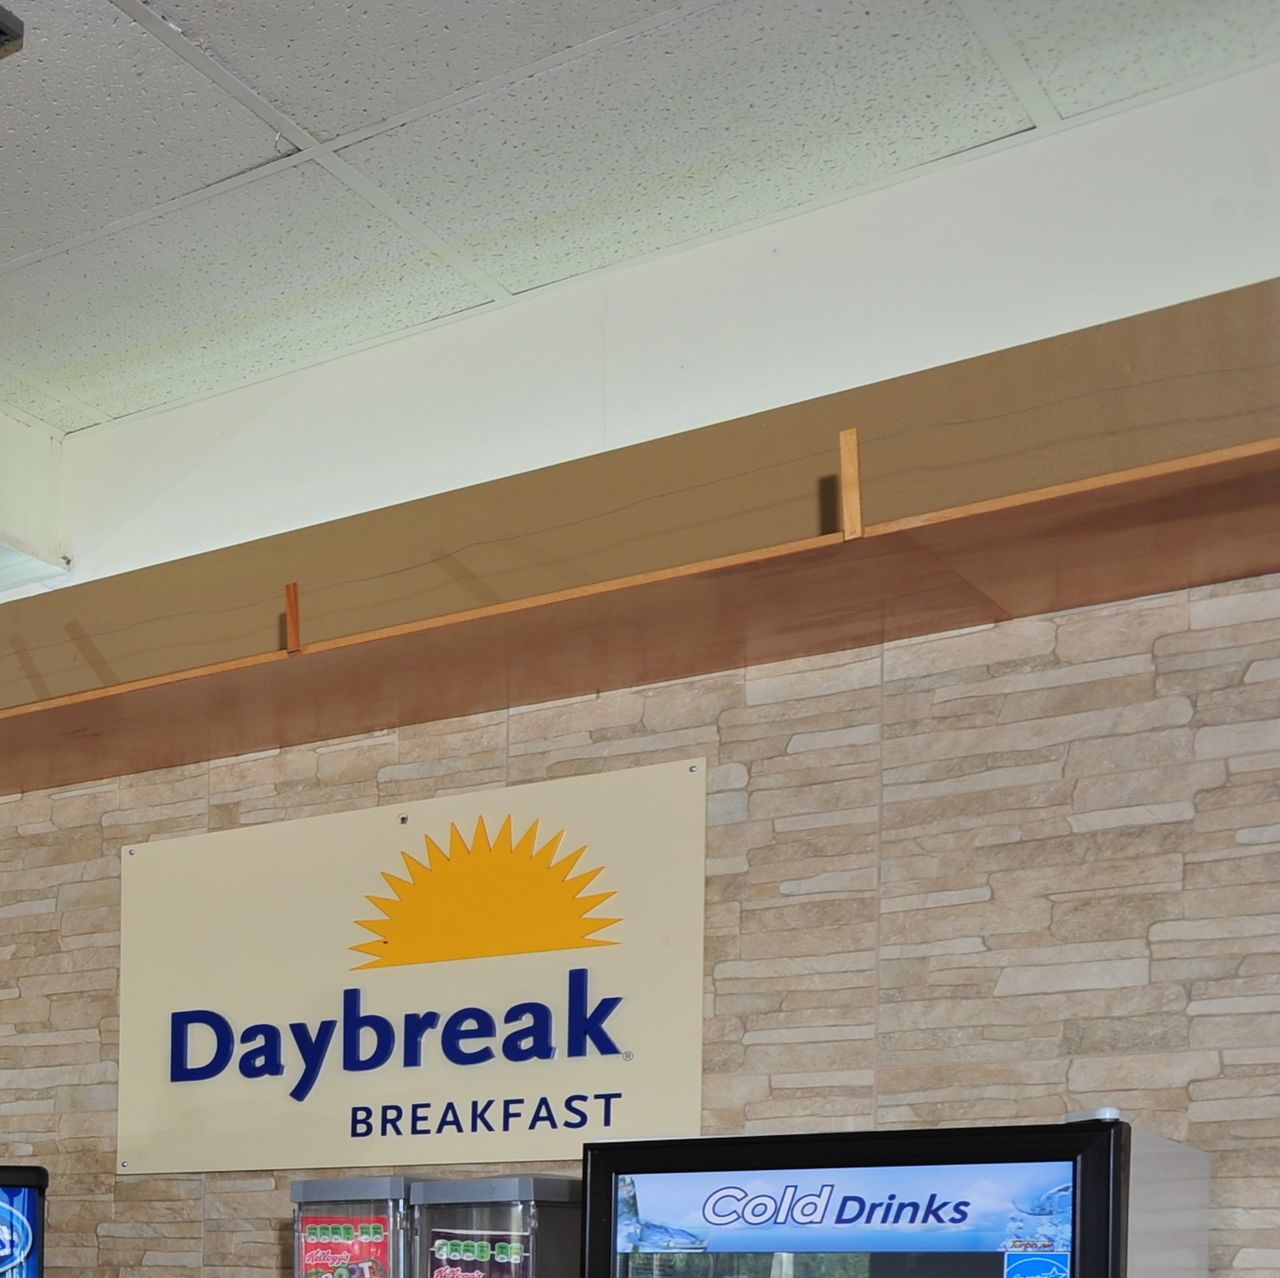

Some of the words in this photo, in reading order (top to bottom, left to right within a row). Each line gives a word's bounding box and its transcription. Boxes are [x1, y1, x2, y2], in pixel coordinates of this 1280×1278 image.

[170, 968, 624, 1102] Daybreak
[350, 1092, 623, 1138] BREAKFAST
[702, 1184, 834, 1226] Cold
[834, 1193, 971, 1226] Drinks
[305, 1250, 350, 1265] Kellogg's
